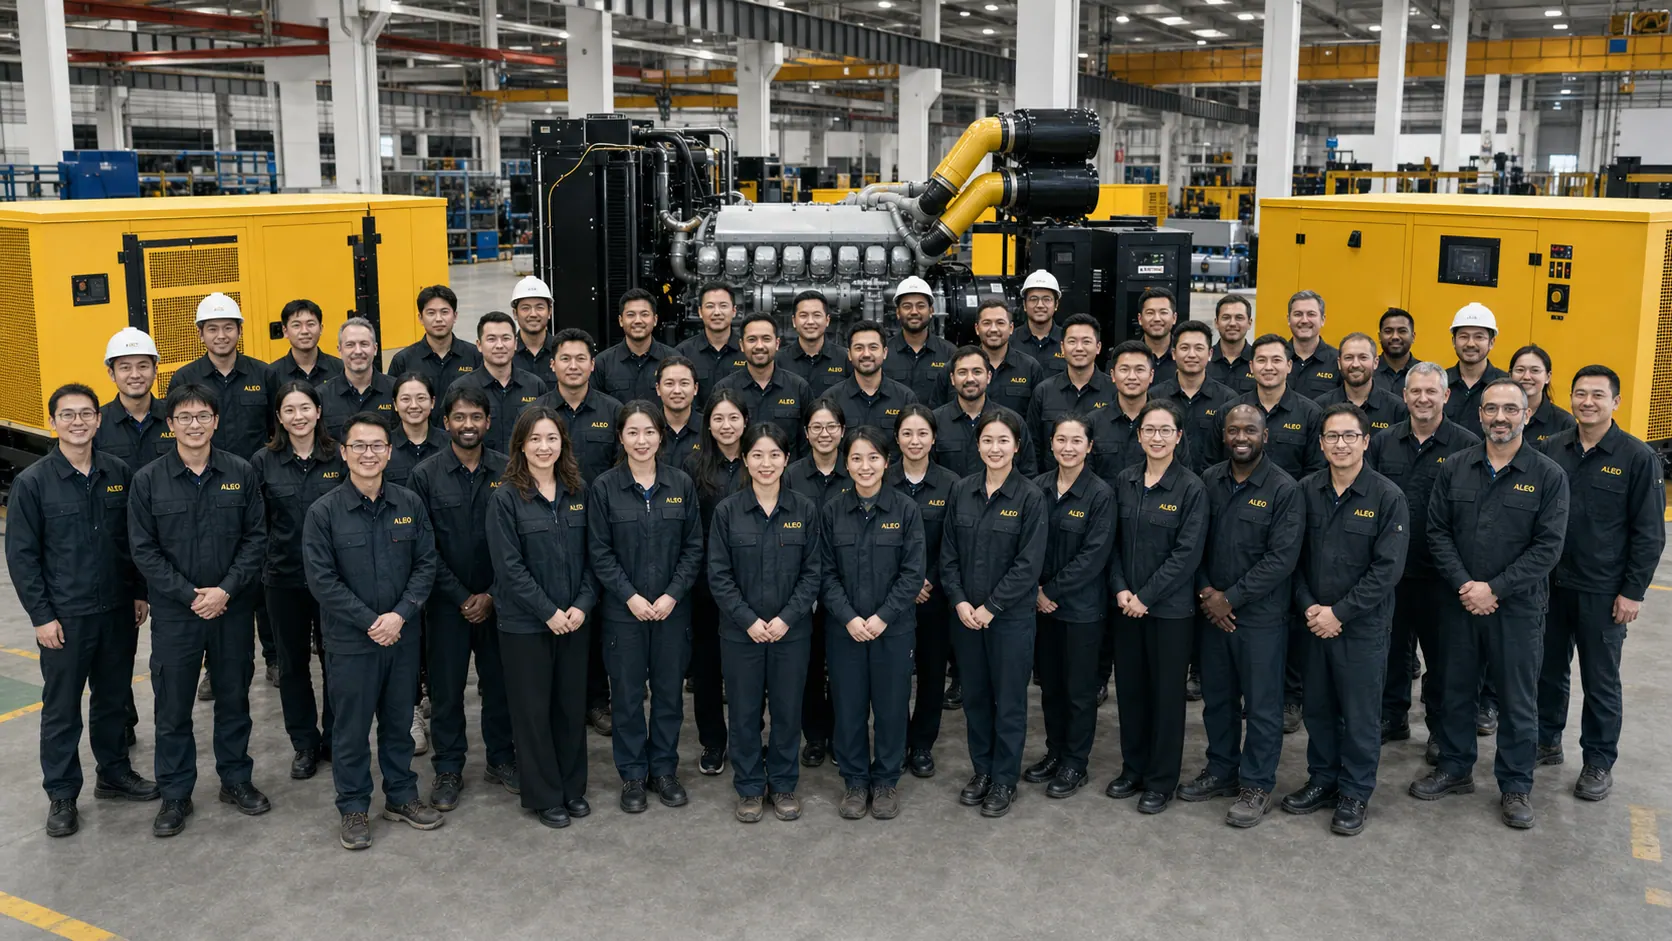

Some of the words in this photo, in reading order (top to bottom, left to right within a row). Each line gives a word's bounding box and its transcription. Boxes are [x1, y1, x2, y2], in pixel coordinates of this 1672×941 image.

[1601, 466, 1621, 475] ALEO
[1514, 484, 1535, 492] ALEO
[1249, 499, 1266, 507] ALEO
[1354, 509, 1374, 517] ALEO
